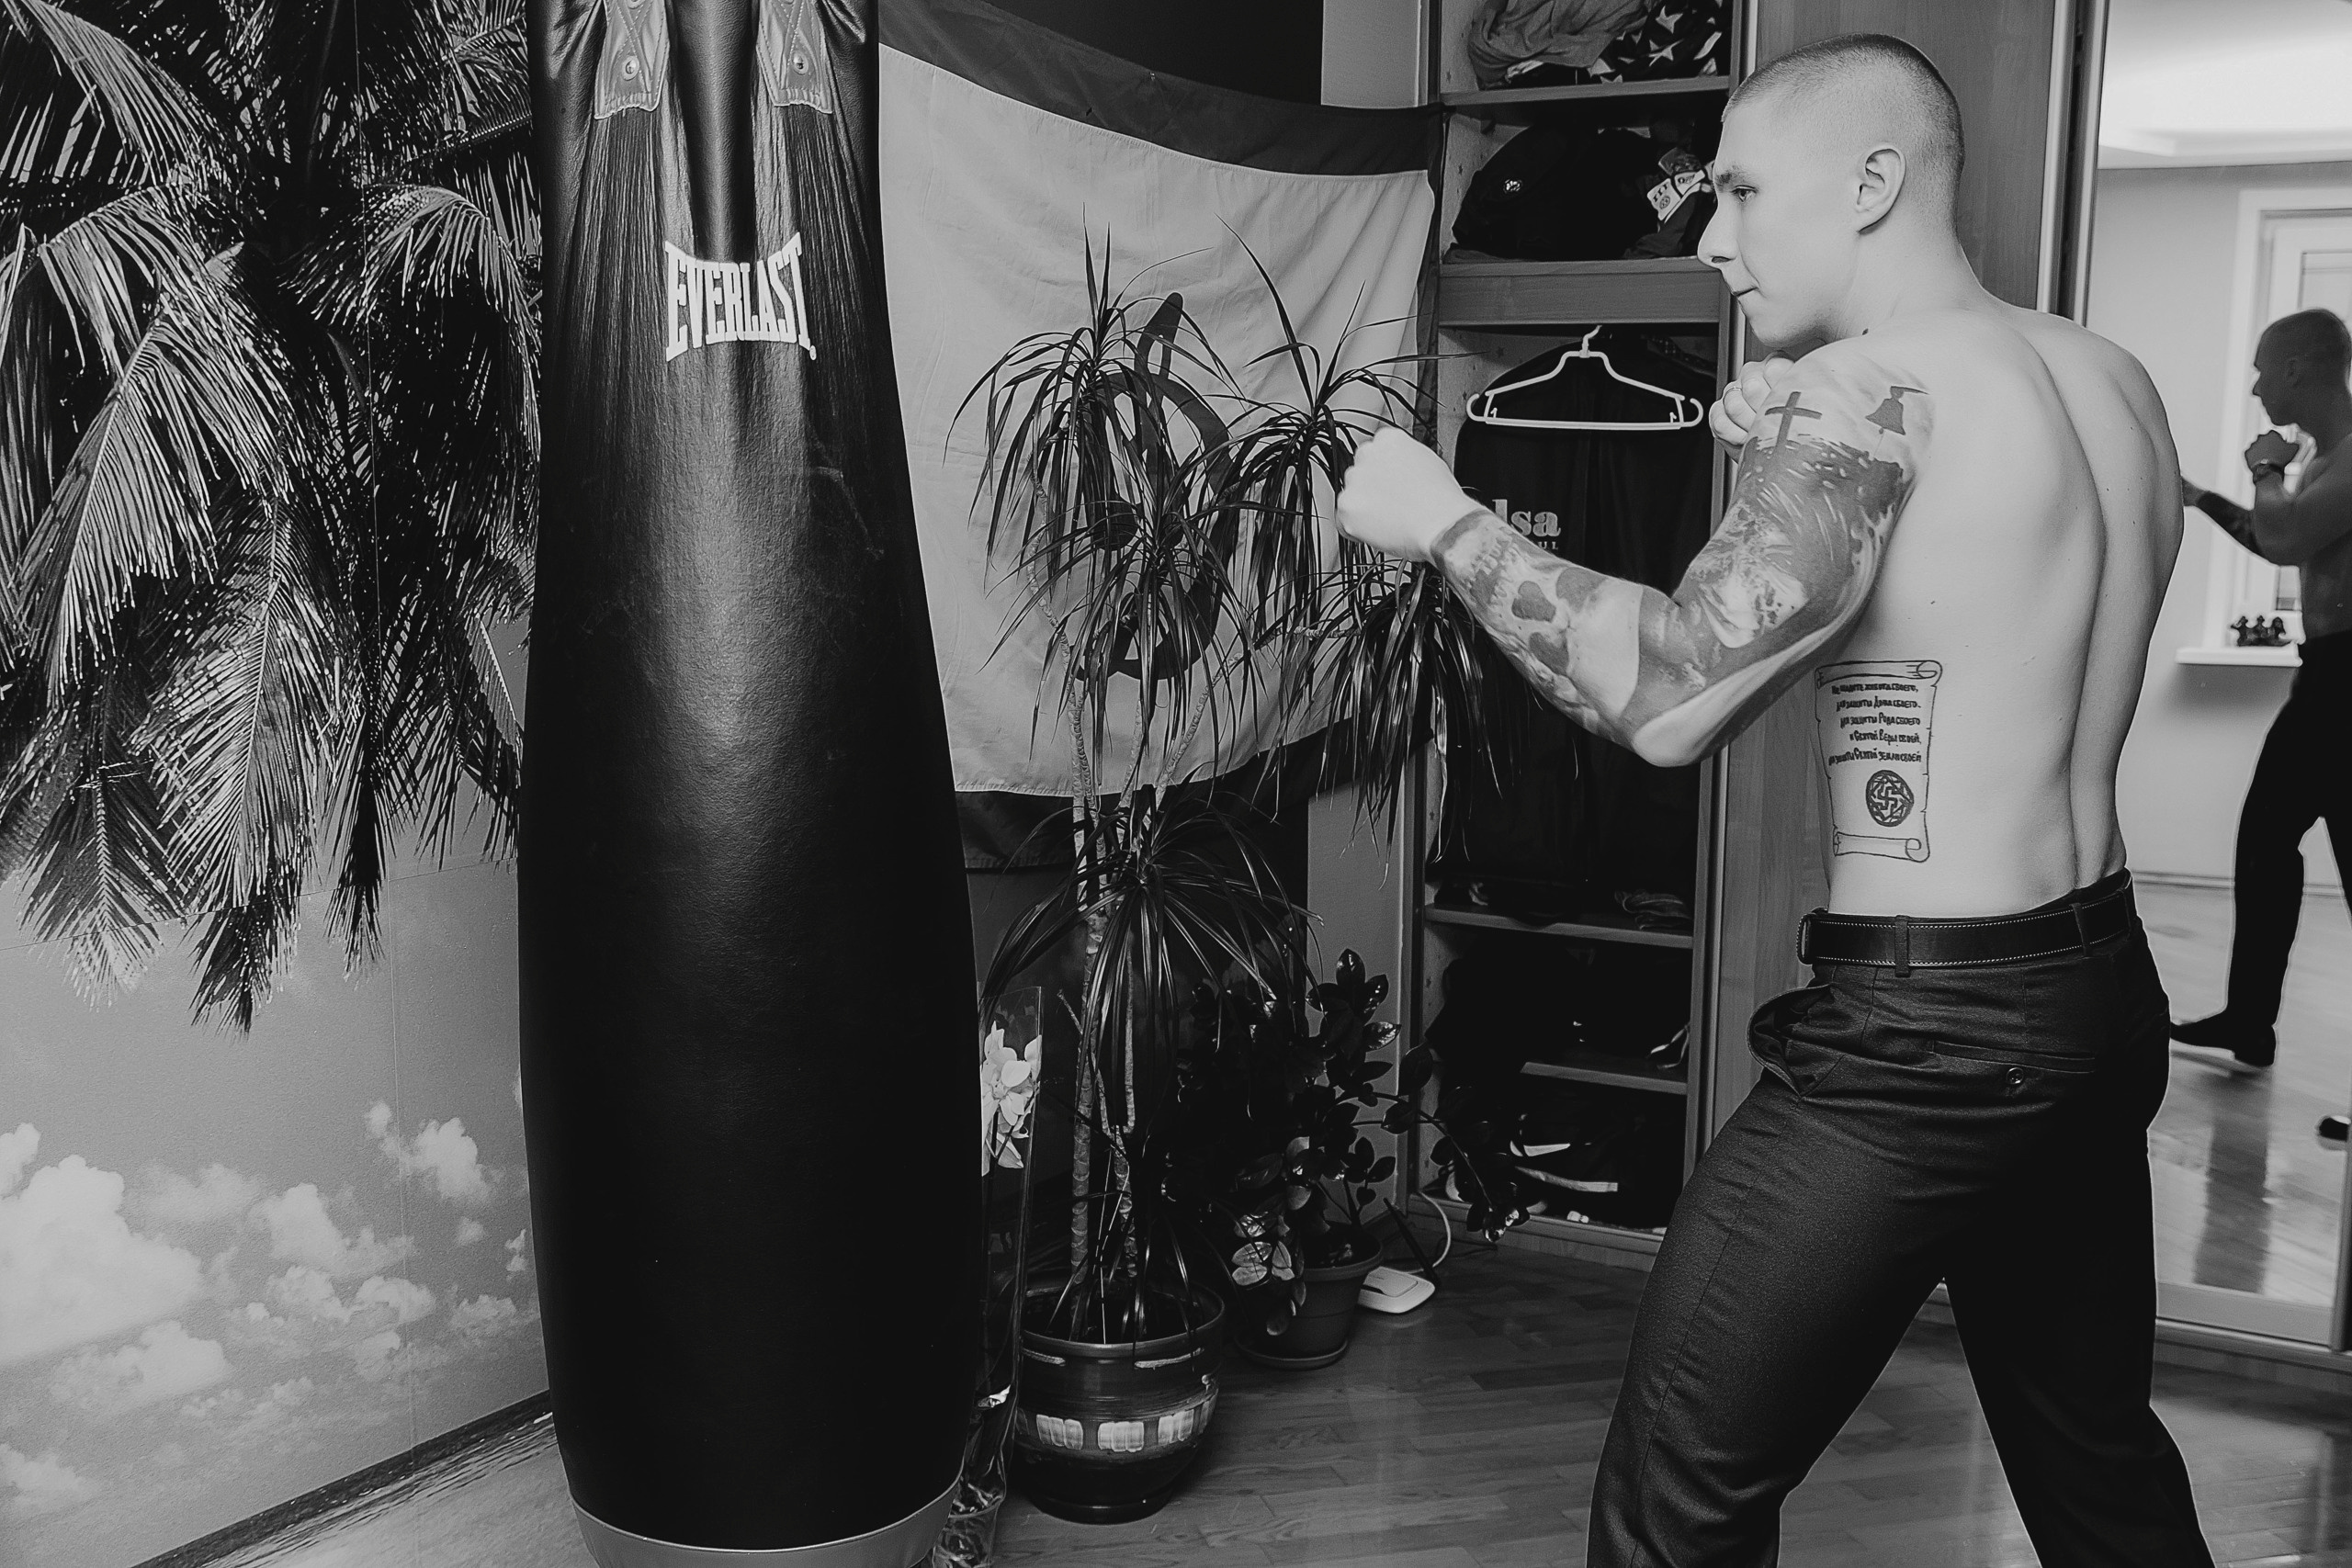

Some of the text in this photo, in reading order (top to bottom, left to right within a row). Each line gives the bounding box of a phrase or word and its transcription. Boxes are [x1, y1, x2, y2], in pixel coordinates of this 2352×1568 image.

[665, 231, 811, 362] EVERLAST
[1491, 499, 1561, 536] lsa
[1537, 541, 1559, 550] UL
